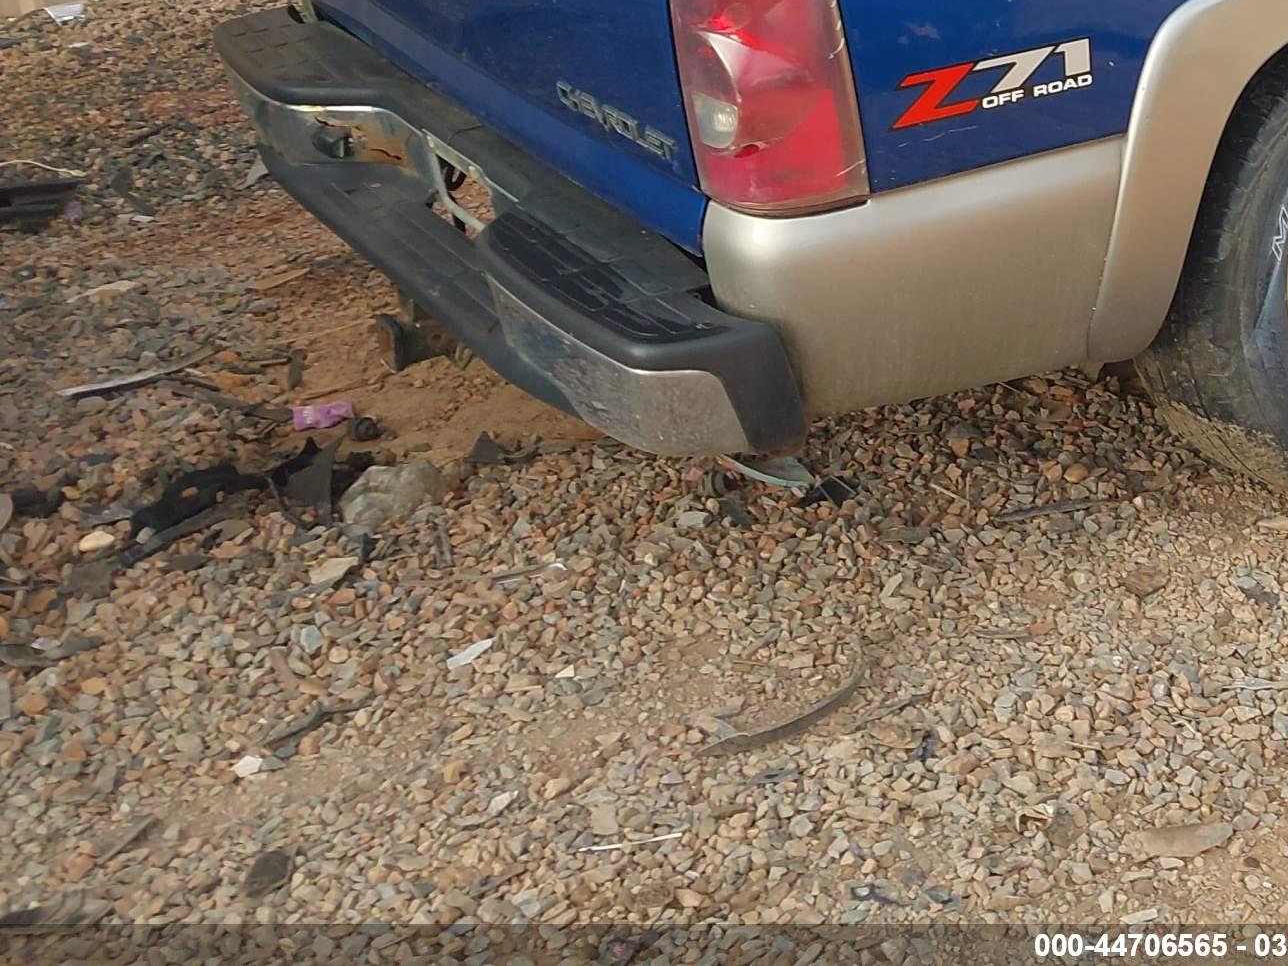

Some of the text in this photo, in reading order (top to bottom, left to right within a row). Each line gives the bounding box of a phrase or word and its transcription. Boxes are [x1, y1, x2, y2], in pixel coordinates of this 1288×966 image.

[556, 80, 677, 162] CHEVROLET
[892, 36, 1092, 130] Z71
[981, 73, 1093, 110] OFF ROAD
